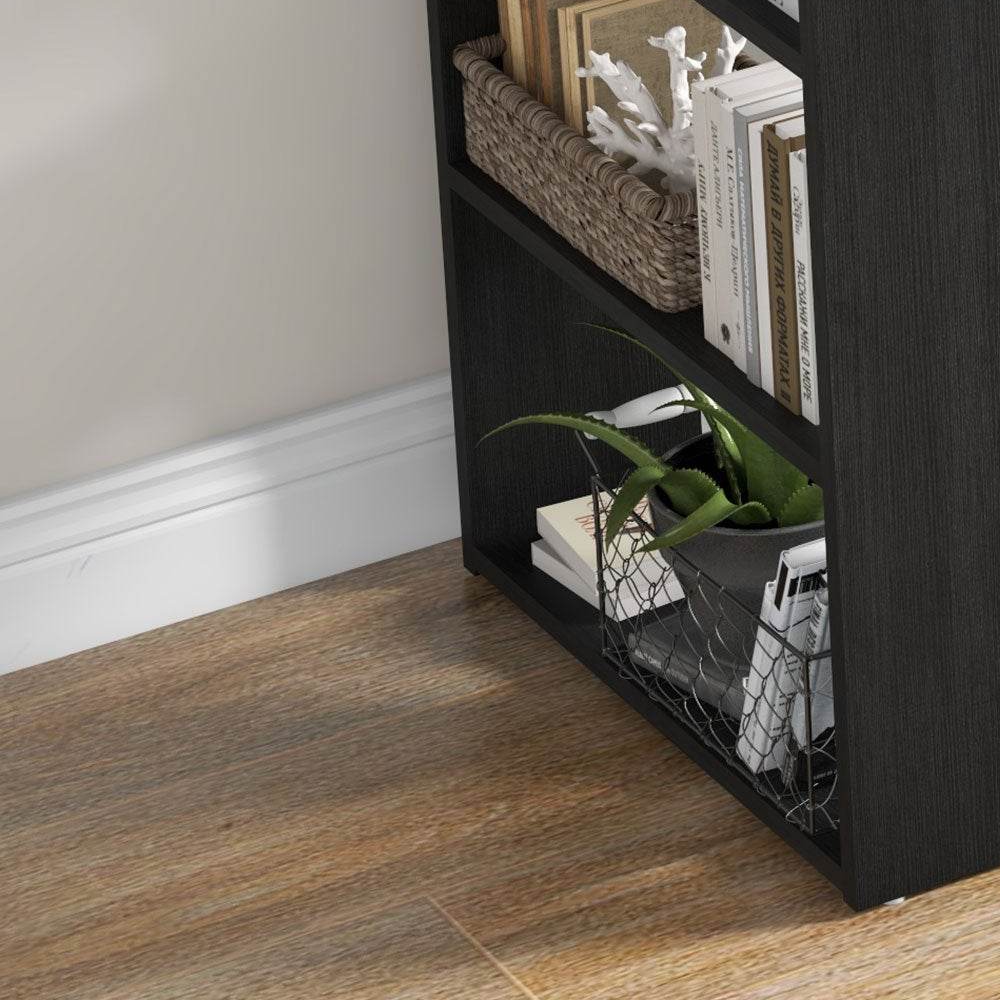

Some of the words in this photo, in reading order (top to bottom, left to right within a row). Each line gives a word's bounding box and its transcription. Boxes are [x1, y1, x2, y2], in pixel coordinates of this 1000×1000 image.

[767, 139, 783, 204] ДУМАЙ
[772, 208, 782, 222] В
[770, 223, 786, 293] ДРУГИХ
[795, 259, 809, 327] РАССКАЖИ
[776, 296, 791, 387] ФОРМАТАХ
[800, 326, 810, 354] МНЕ
[801, 356, 811, 368] О
[802, 368, 813, 403] МОРЕ
